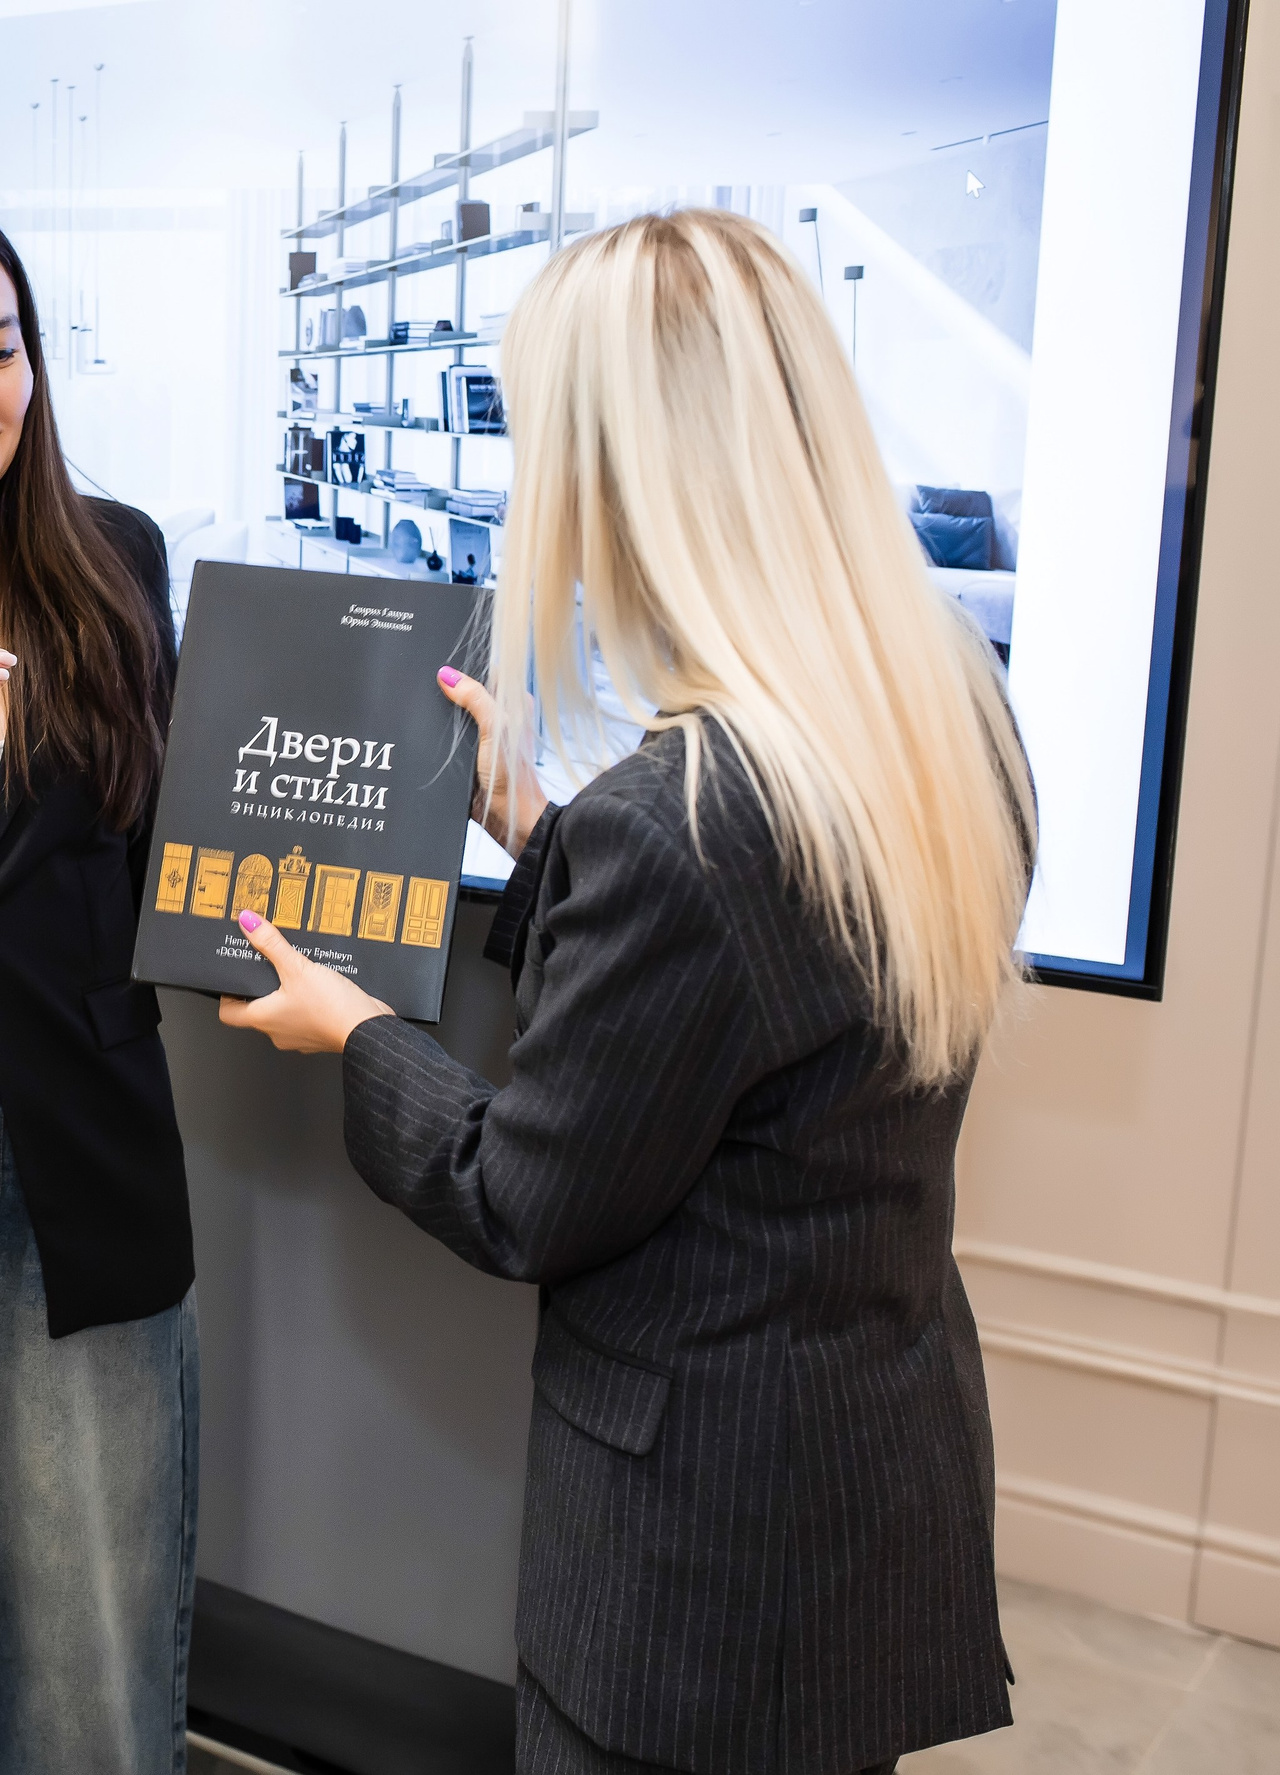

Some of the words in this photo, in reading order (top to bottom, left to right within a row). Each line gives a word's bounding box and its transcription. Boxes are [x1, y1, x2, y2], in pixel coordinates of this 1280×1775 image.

[238, 715, 396, 780] Двери
[232, 768, 261, 795] и
[270, 773, 389, 810] стили
[230, 800, 386, 832] ЭНЦИКЛОПЕДИЯ
[224, 934, 250, 949] Henry
[313, 947, 353, 963] Epshteyn
